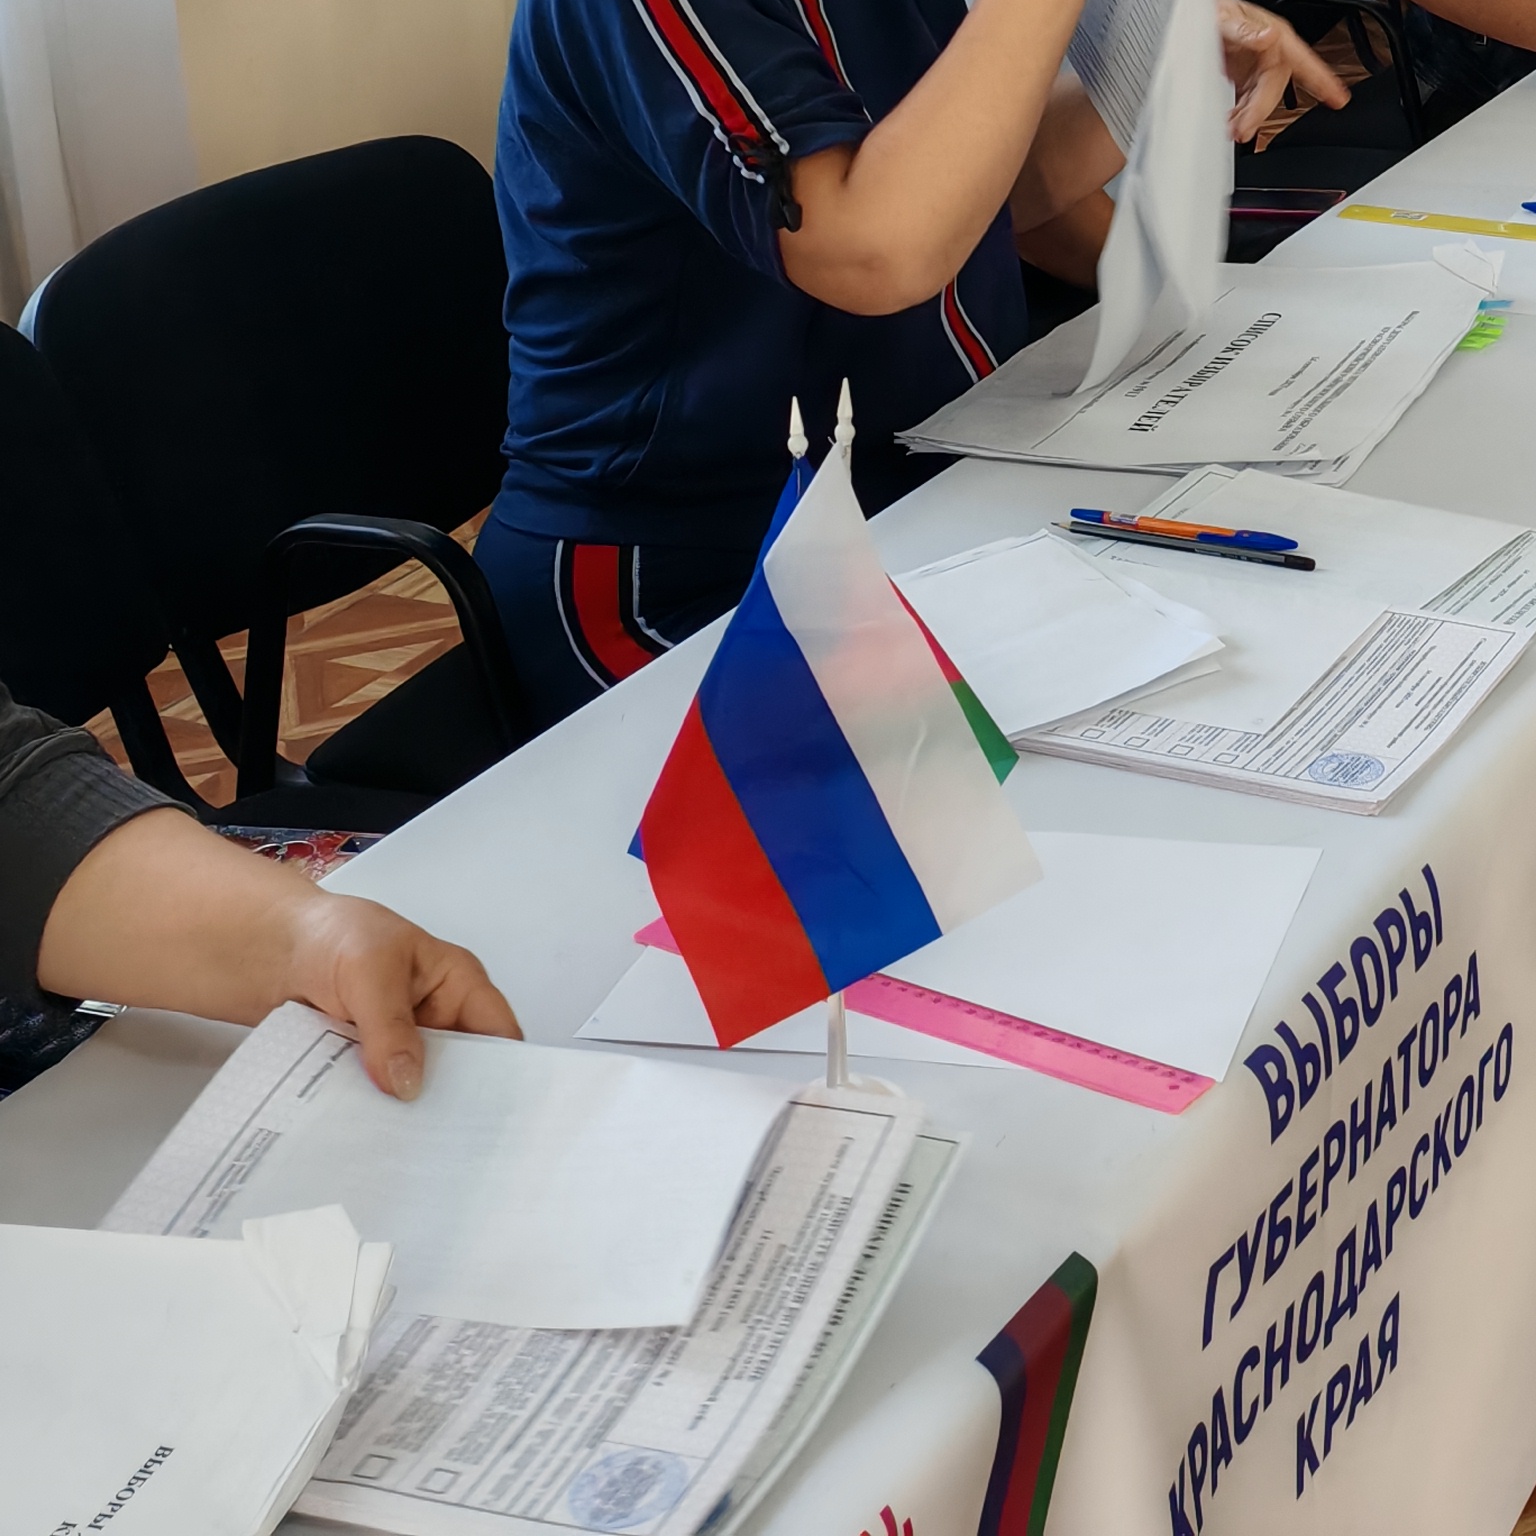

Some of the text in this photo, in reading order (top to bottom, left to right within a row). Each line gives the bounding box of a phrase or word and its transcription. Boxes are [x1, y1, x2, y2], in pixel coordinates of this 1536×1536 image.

[1220, 312, 1282, 355] СПИСОК
[1243, 864, 1443, 1146] ВЫБОРЫ
[1202, 950, 1482, 1350] ГУБЕРНАТОРА
[1168, 1022, 1514, 1536] КРАСНОДАРСКОГО
[1296, 1291, 1401, 1500] КРАЯ
[86, 1445, 176, 1531] ВЫБОРЫ
